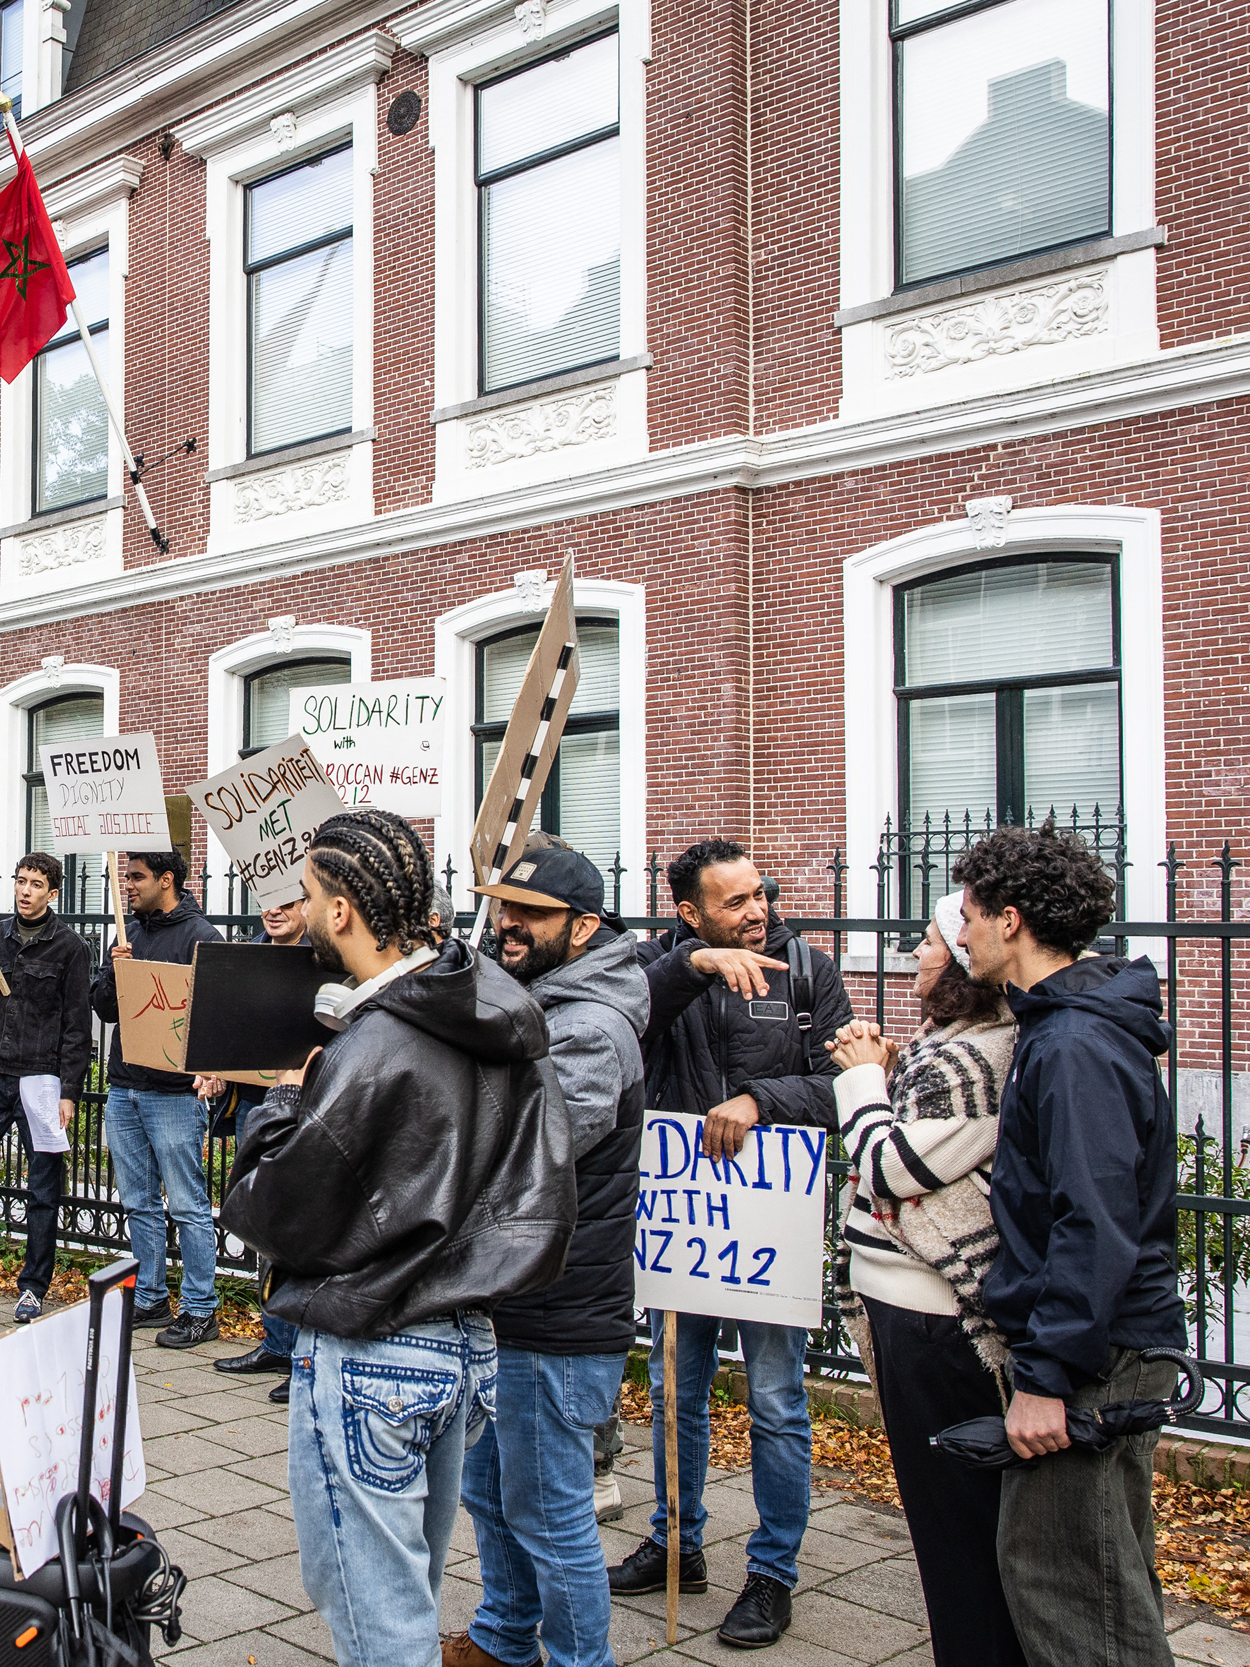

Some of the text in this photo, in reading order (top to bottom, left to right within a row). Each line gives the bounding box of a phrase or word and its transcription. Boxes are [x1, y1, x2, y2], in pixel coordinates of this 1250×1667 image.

[333, 735, 357, 750] with
[50, 747, 141, 777] FREEDOM
[320, 762, 385, 787] ROCCAN
[58, 776, 126, 810] DIGNITY
[52, 811, 155, 838] SOCIAL JUSTICE
[258, 798, 293, 843] MET
[635, 1189, 731, 1231] WITH
[634, 1228, 777, 1287] NZ 212
